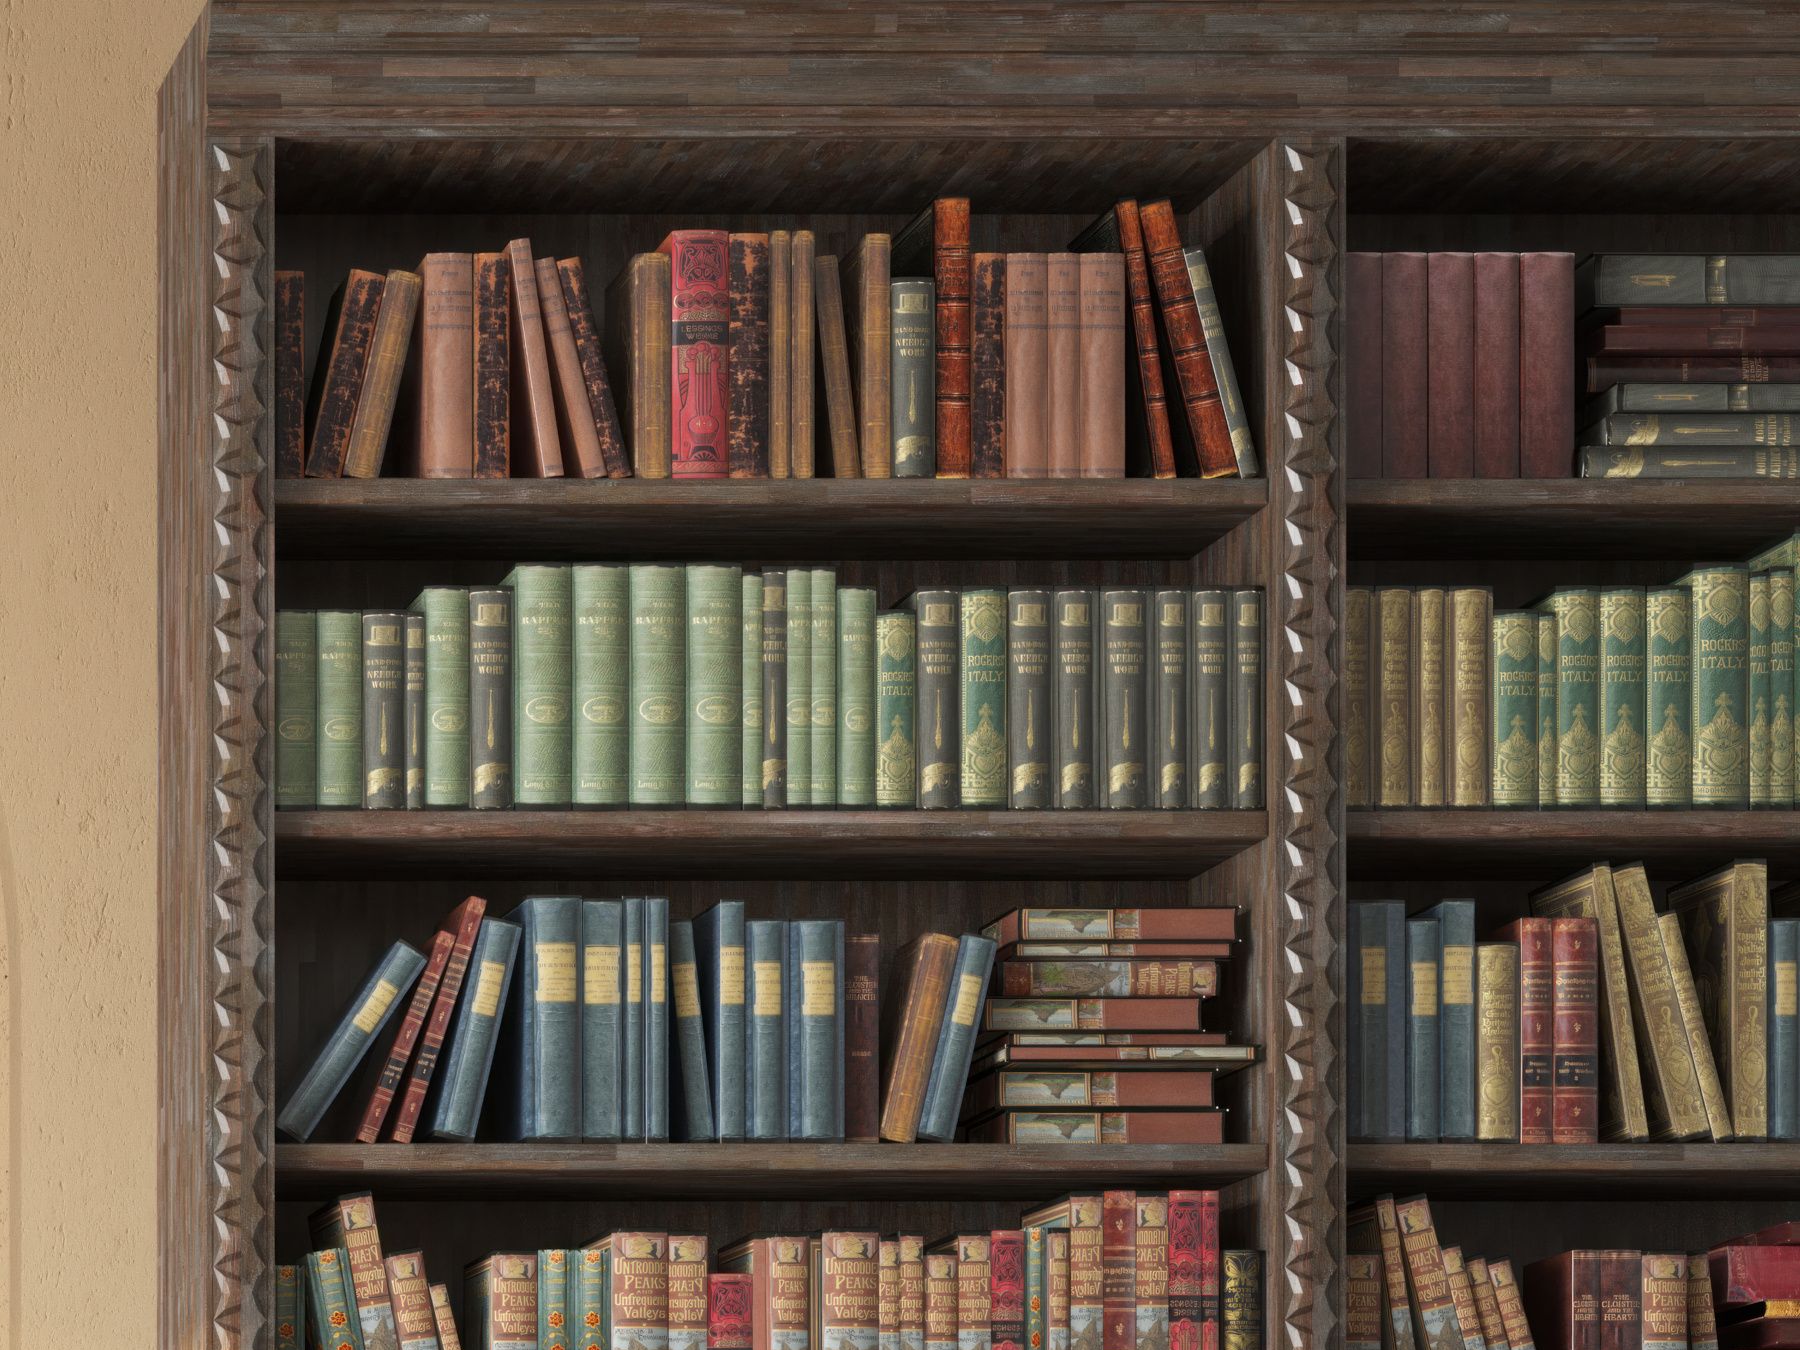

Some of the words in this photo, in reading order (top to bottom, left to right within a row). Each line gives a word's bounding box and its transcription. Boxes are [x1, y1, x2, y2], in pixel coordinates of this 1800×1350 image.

[624, 1275, 666, 1290] PEAKS
[835, 1275, 877, 1290] PEAKS
[623, 1306, 666, 1321] Valleys
[834, 1306, 878, 1320] Valleys
